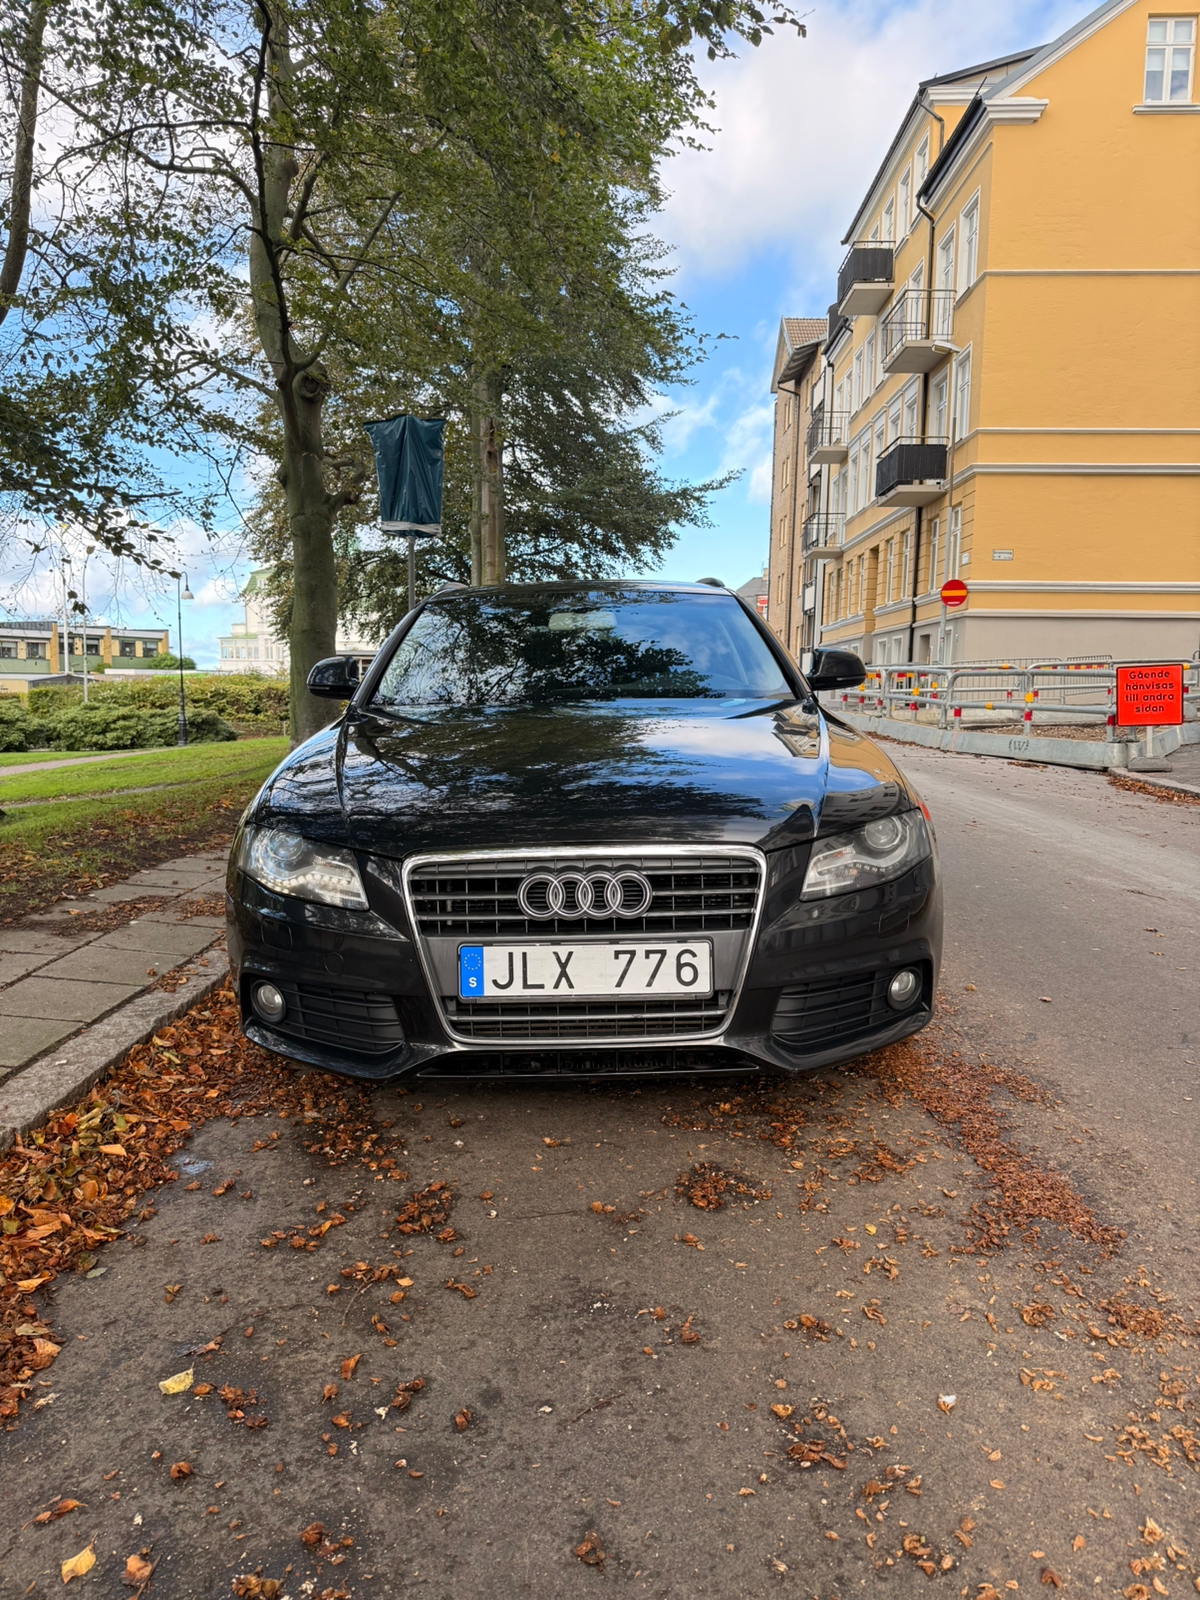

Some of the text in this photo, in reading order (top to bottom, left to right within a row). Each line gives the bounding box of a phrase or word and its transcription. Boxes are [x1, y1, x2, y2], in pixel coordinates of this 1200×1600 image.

[1129, 670, 1170, 680] Gående
[1125, 681, 1174, 691] hänvisas
[1125, 693, 1174, 702] till andra
[1135, 704, 1165, 713] sidan
[491, 948, 699, 990] JLX 776
[468, 976, 477, 988] S
